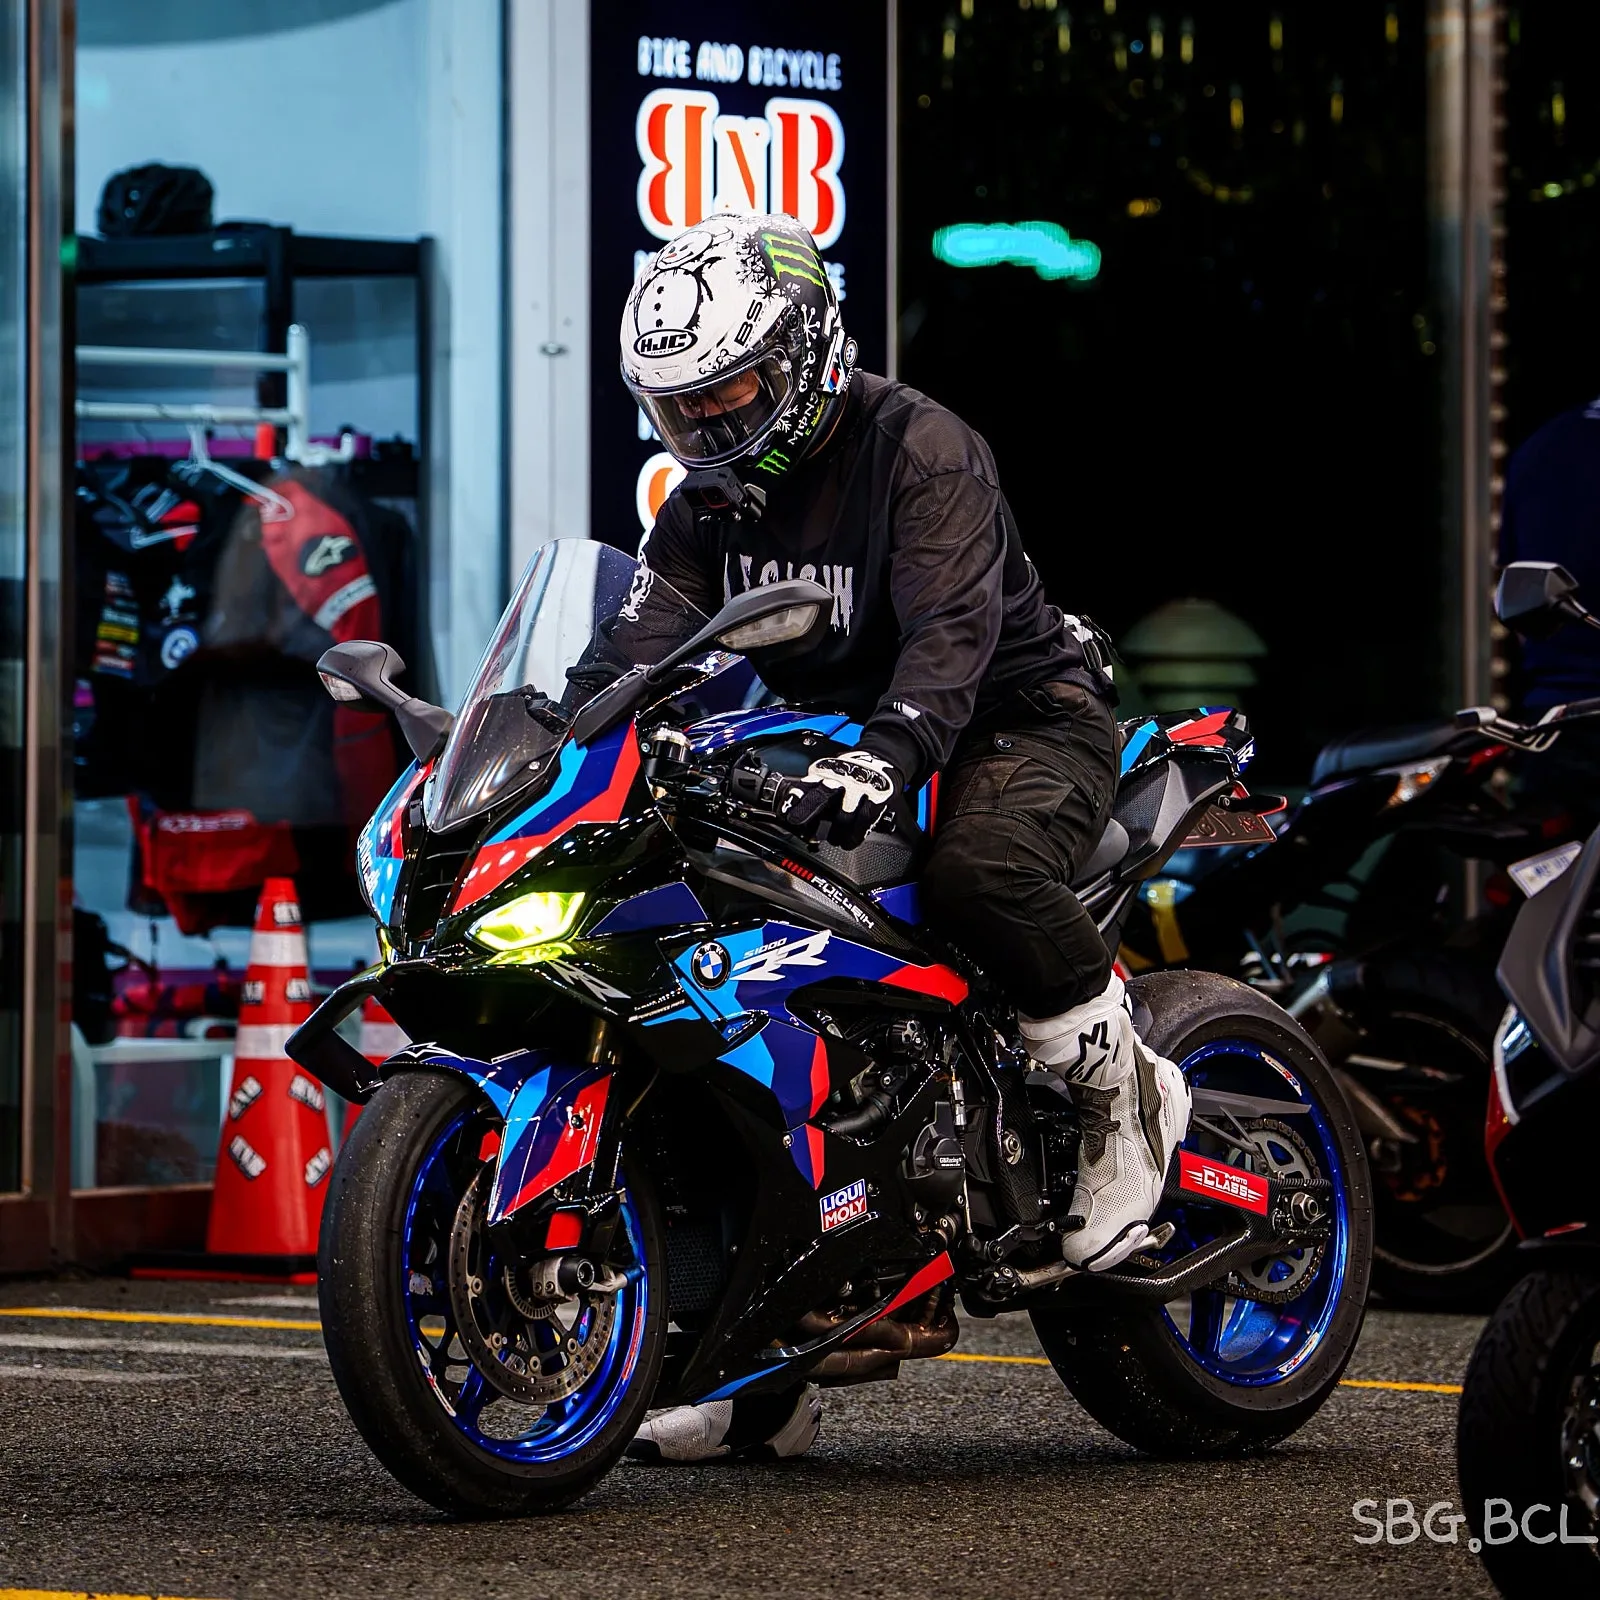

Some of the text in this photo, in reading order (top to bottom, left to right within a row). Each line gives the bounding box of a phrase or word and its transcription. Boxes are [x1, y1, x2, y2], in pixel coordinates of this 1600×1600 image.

[637, 35, 842, 91] BIKE AND BICYCLE
[640, 333, 688, 353] HJC
[743, 937, 788, 959] S1000
[1203, 1168, 1248, 1198] CLASS
[1224, 1172, 1248, 1186] MOTO
[823, 1182, 863, 1213] LIQUI
[824, 1197, 865, 1229] MOLY
